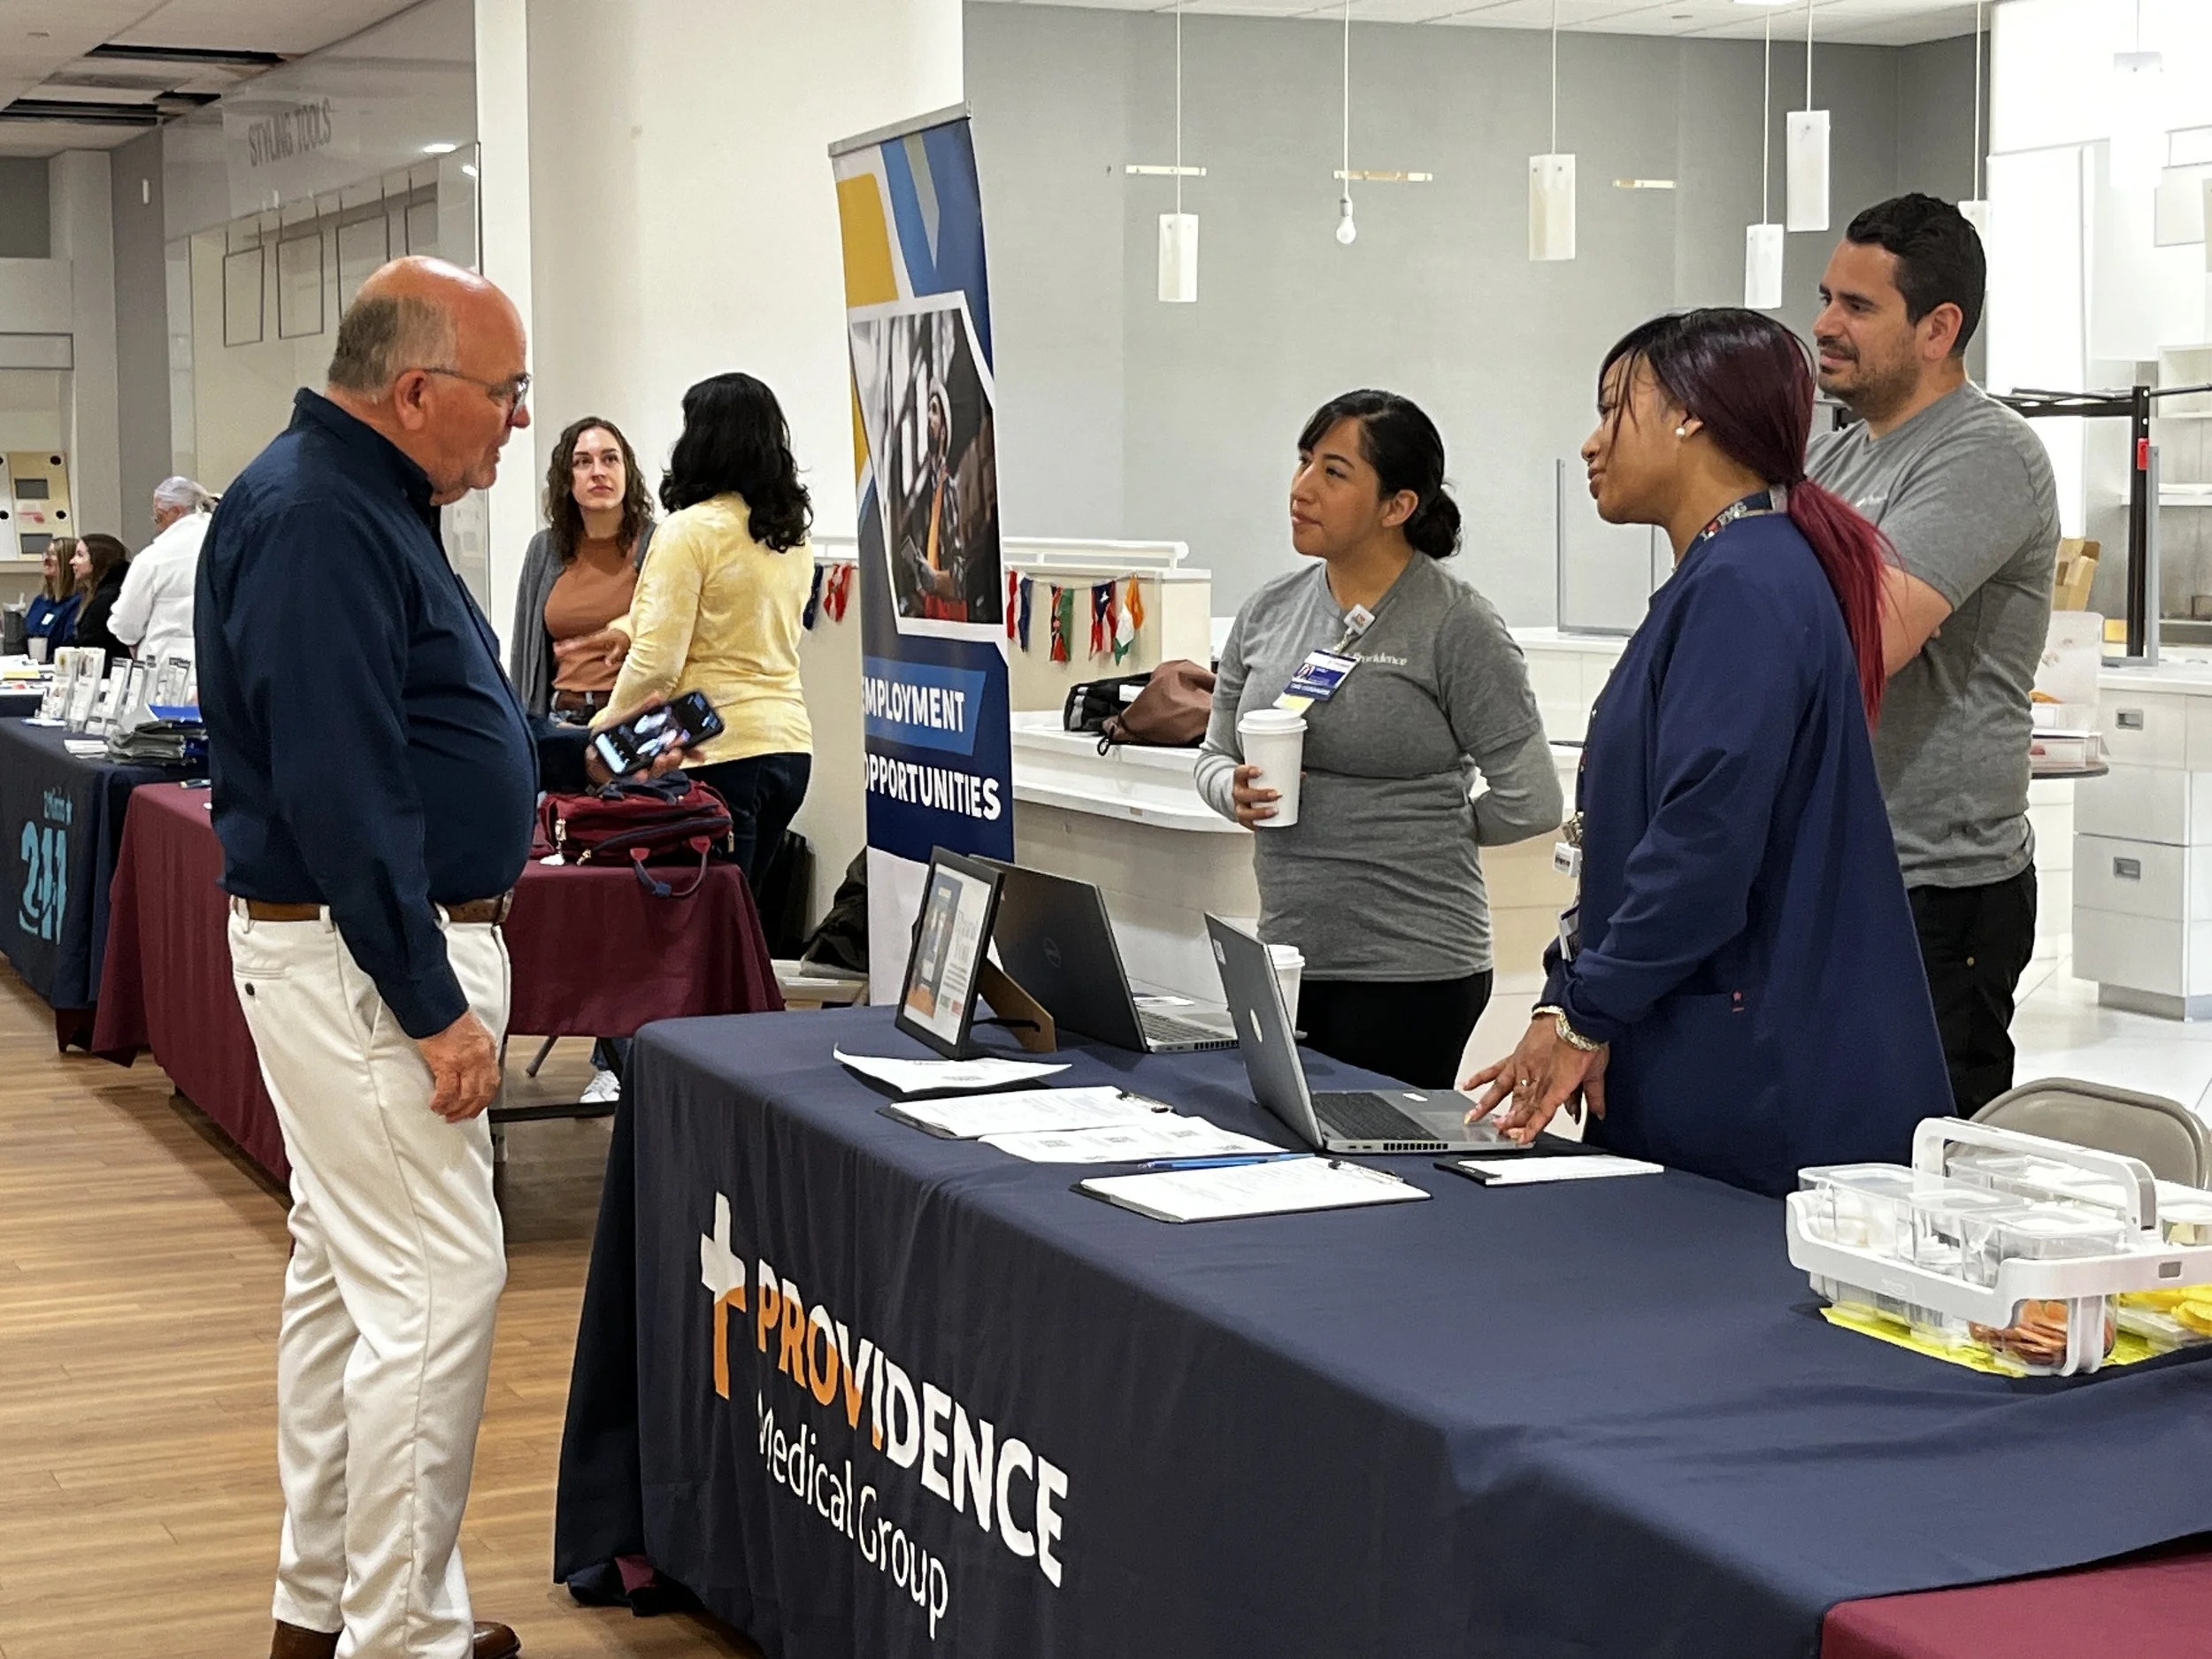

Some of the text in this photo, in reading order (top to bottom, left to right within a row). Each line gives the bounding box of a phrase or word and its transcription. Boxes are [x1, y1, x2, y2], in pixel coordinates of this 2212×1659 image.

[249, 96, 332, 167] STYLING TOOLS
[19, 820, 67, 945] 211
[757, 1258, 1070, 1589] PROVIDENCE
[858, 1485, 949, 1640] Group
